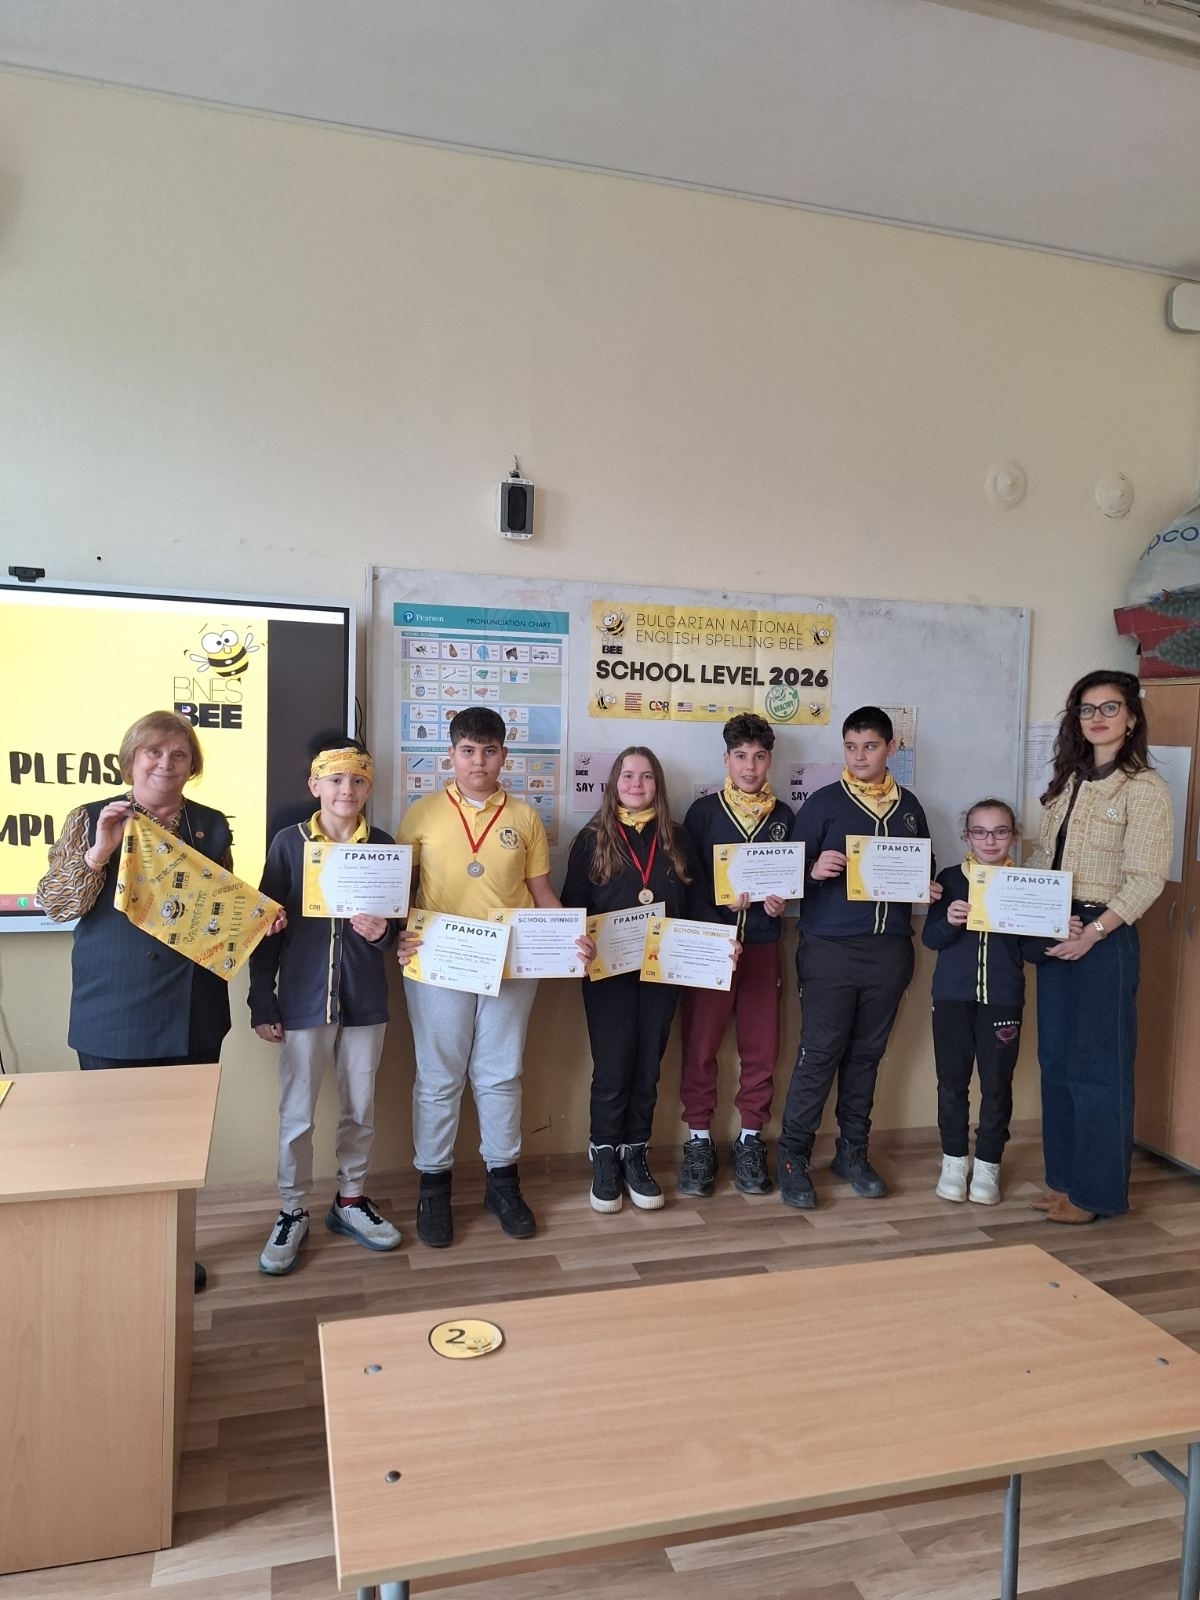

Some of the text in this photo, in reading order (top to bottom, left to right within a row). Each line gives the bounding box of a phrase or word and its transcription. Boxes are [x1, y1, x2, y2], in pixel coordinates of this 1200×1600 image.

[416, 615, 444, 623] Pearson
[466, 618, 526, 628] PRONUNCIATION
[636, 613, 803, 635] BULGARIAN NATIONAL
[636, 629, 803, 651] ENGLISH SPELLING BEE
[602, 645, 623, 654] BEE
[596, 660, 829, 688] SCHOOL LEVEL 2026
[174, 676, 243, 703] BNES
[174, 702, 243, 729] BEE
[9, 751, 124, 785] PLEAS
[576, 783, 594, 793] SAY
[792, 791, 809, 801] SAY
[877, 844, 921, 853] ГРАМОТА
[345, 852, 400, 861] ГРАМОТА
[1006, 875, 1060, 886] ГРАМОТА
[613, 911, 656, 925] ГРАМОТА
[445, 923, 497, 939] ГРАМОТА
[673, 926, 700, 935] SCHOOL
[445, 1328, 466, 1344] 2
